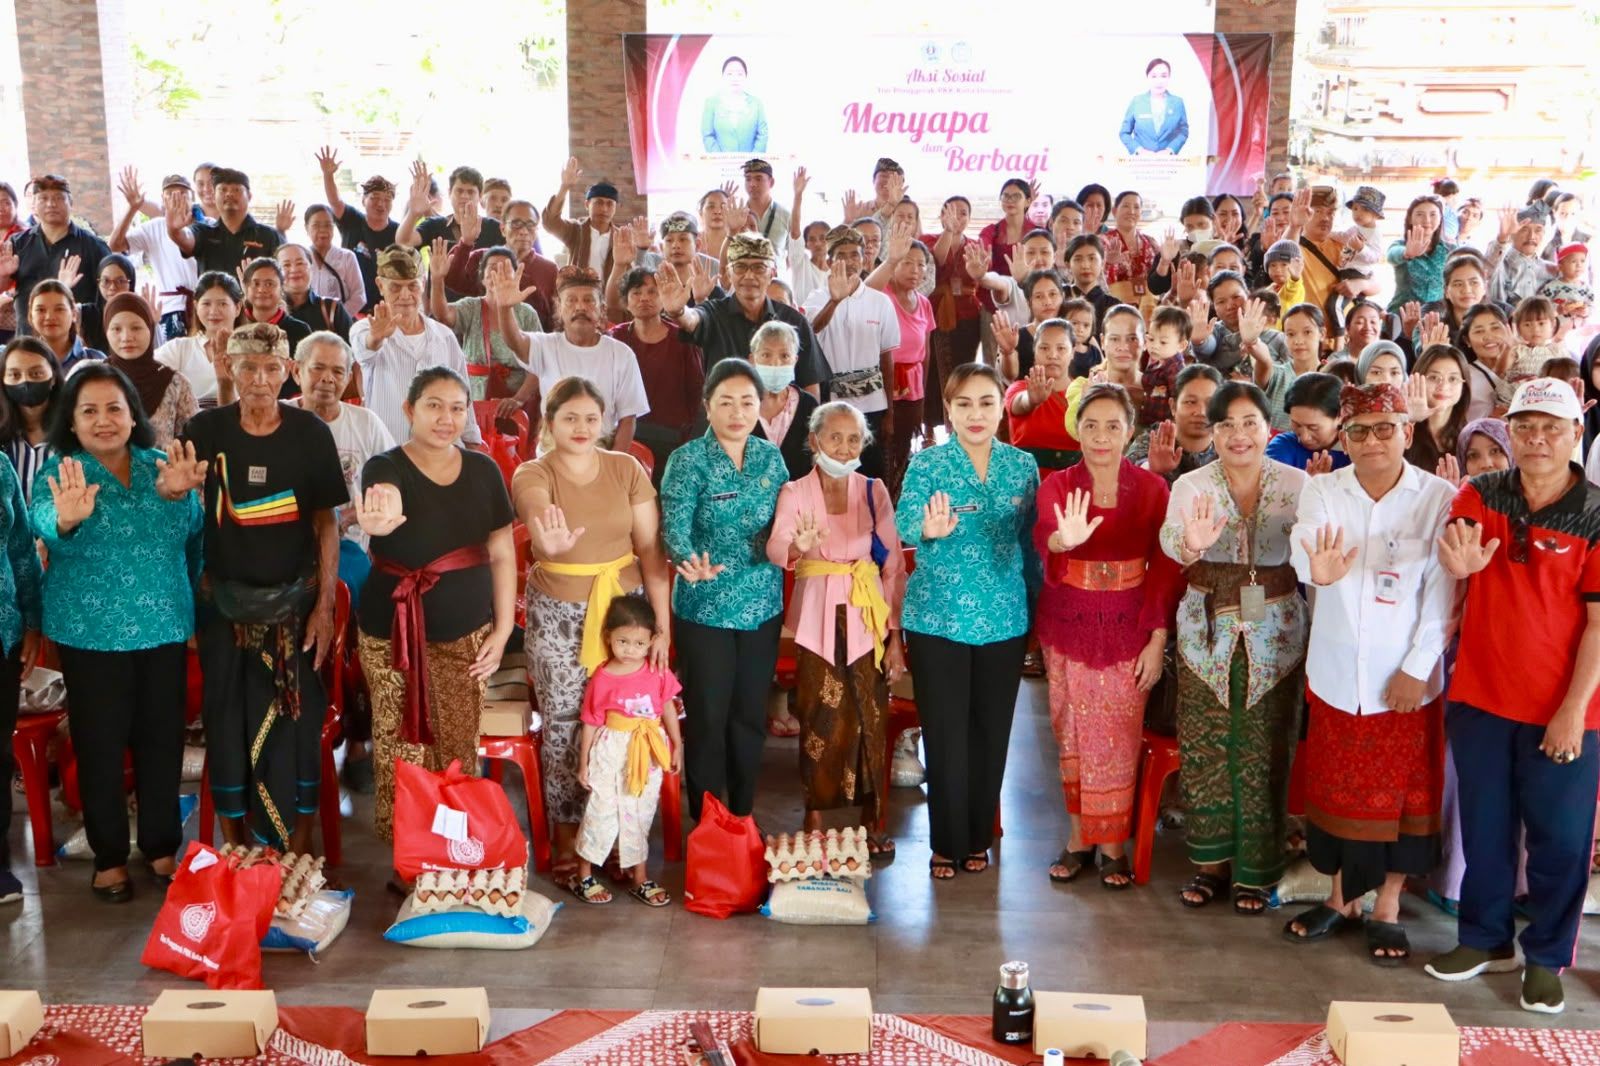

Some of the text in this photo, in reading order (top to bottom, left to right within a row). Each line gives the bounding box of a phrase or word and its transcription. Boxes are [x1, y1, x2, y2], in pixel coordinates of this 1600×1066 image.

[906, 68, 985, 84] Aksi Sosial
[843, 102, 990, 143] Menyapa
[922, 143, 944, 153] dan
[945, 146, 1050, 180] Berbagi
